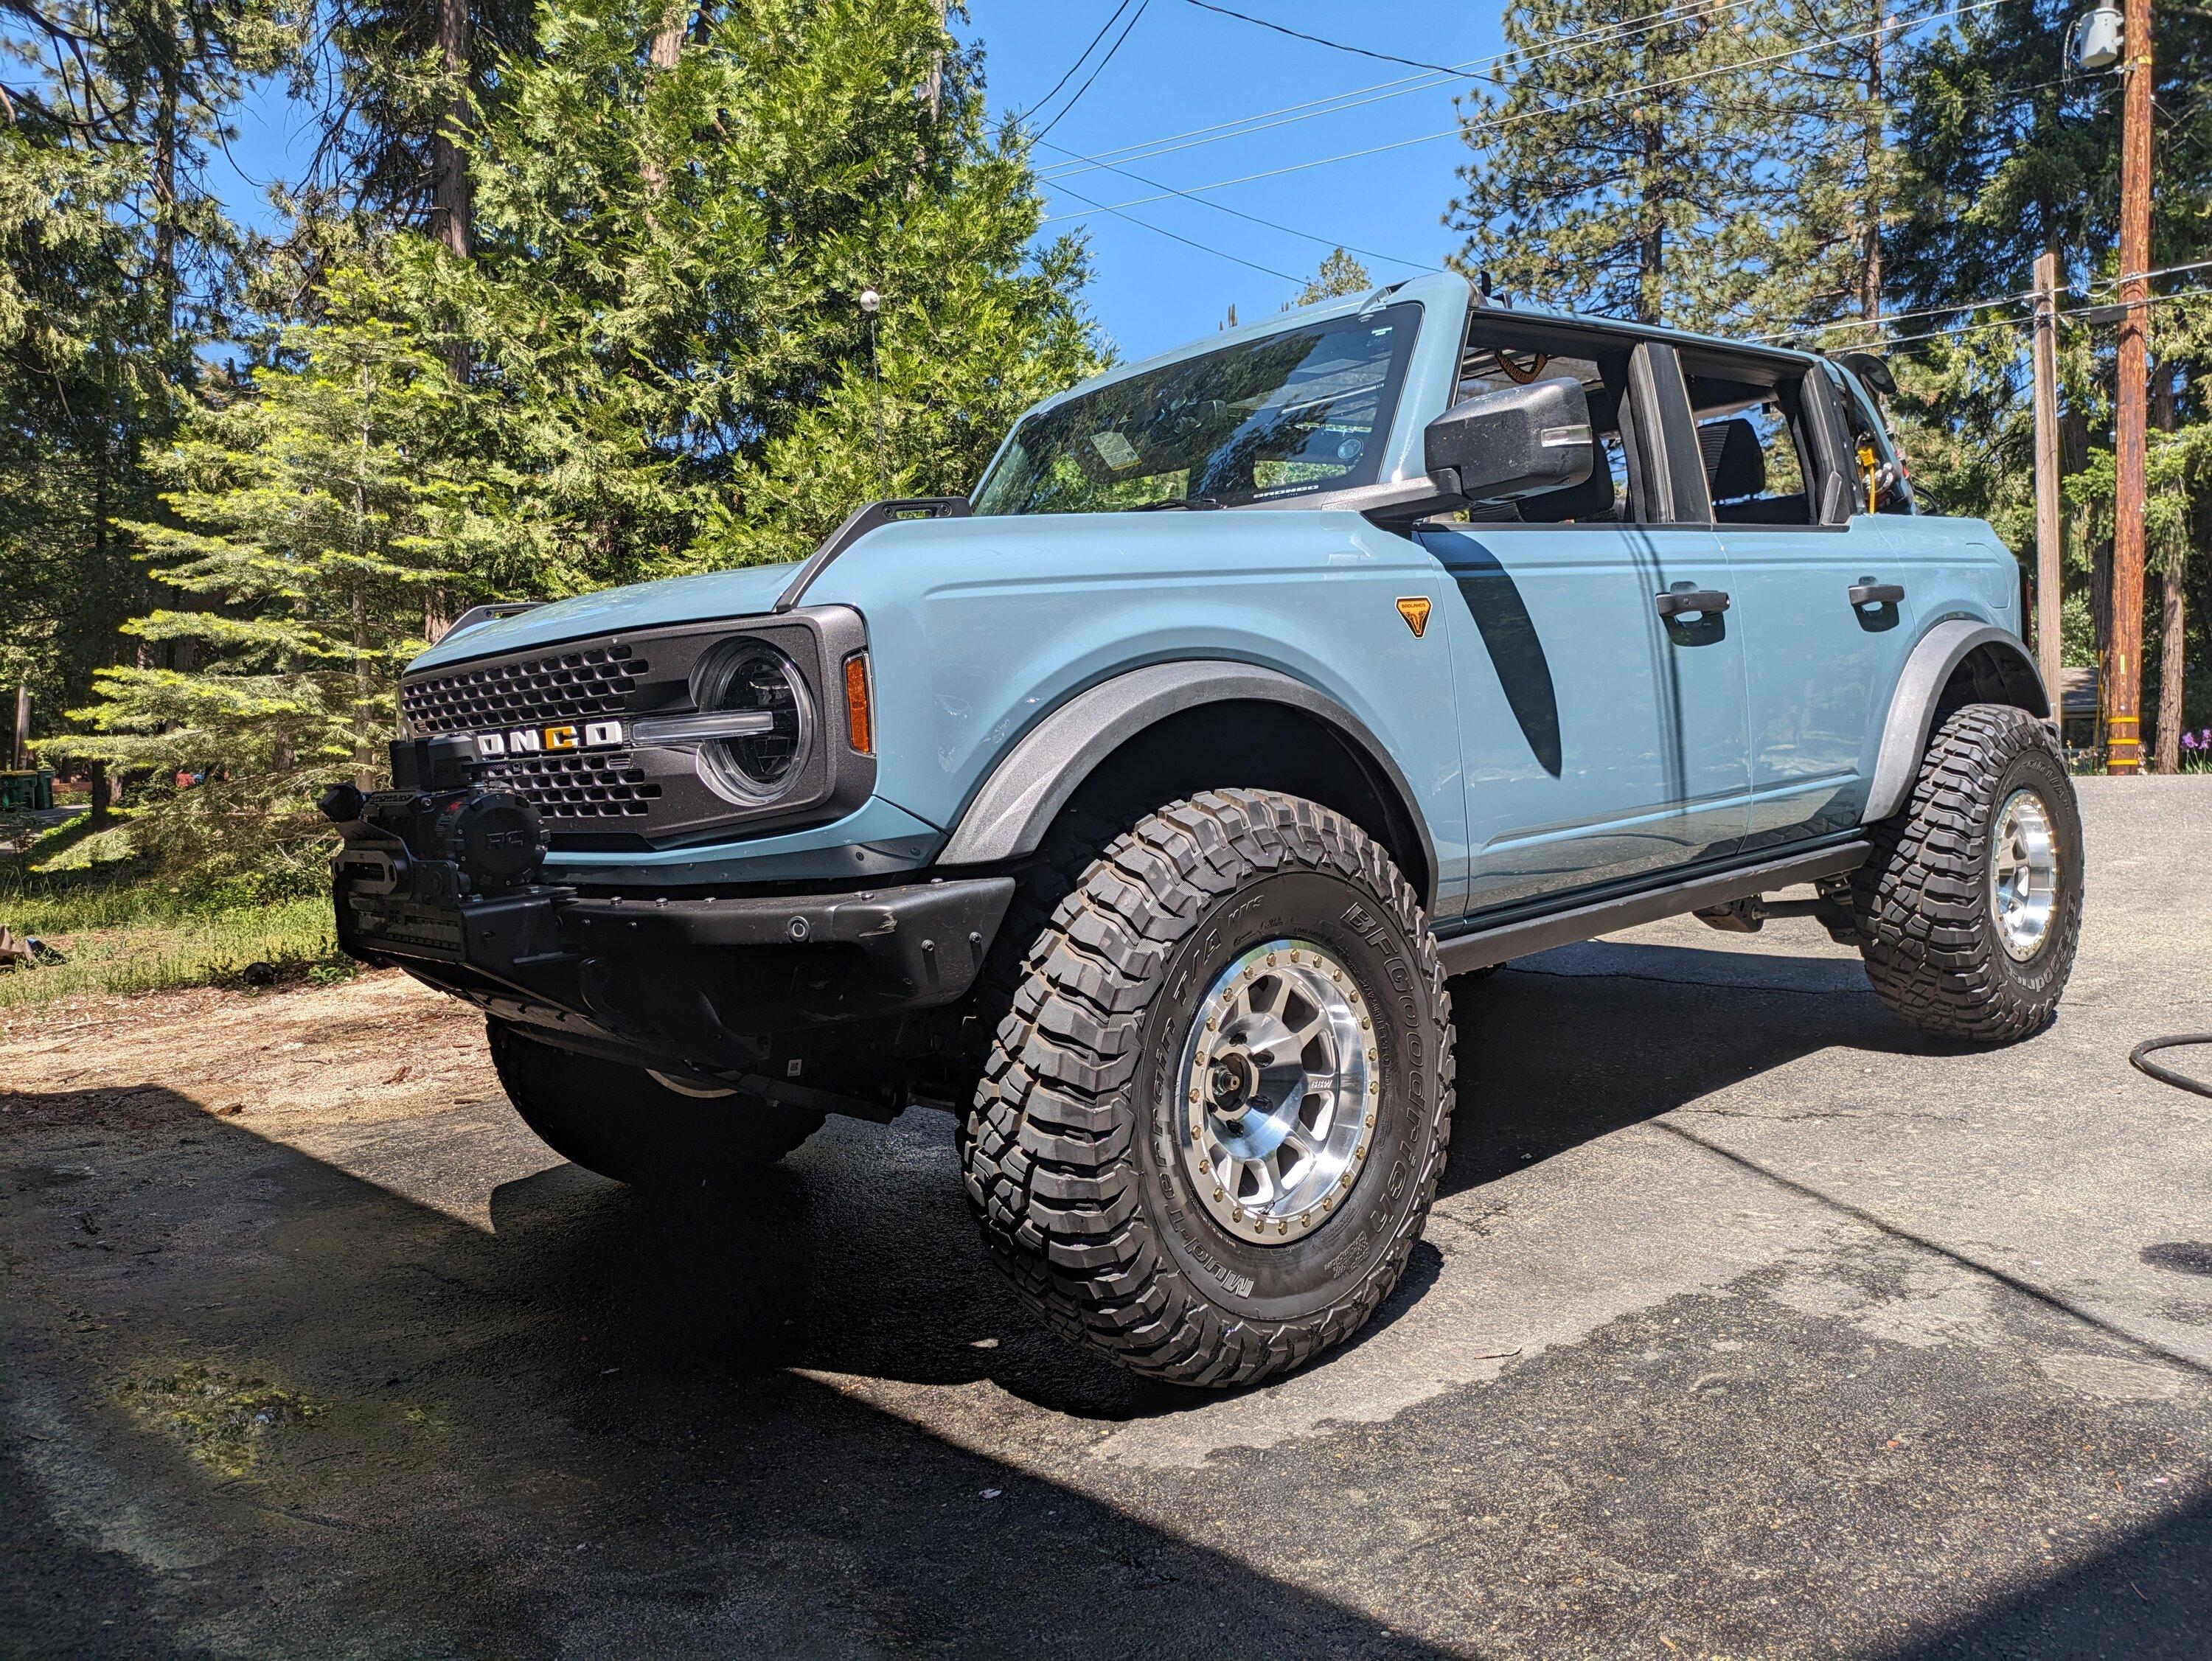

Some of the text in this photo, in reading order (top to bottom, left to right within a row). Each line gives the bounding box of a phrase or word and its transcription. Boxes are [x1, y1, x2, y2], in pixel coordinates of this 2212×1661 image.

[1253, 485, 1320, 499] BRONCO
[478, 720, 623, 755] ONCO
[1172, 928, 1222, 1007] T/A
[1340, 902, 1427, 1233] BFGoodrich
[1152, 1017, 1255, 1300] Mud-Terrain
